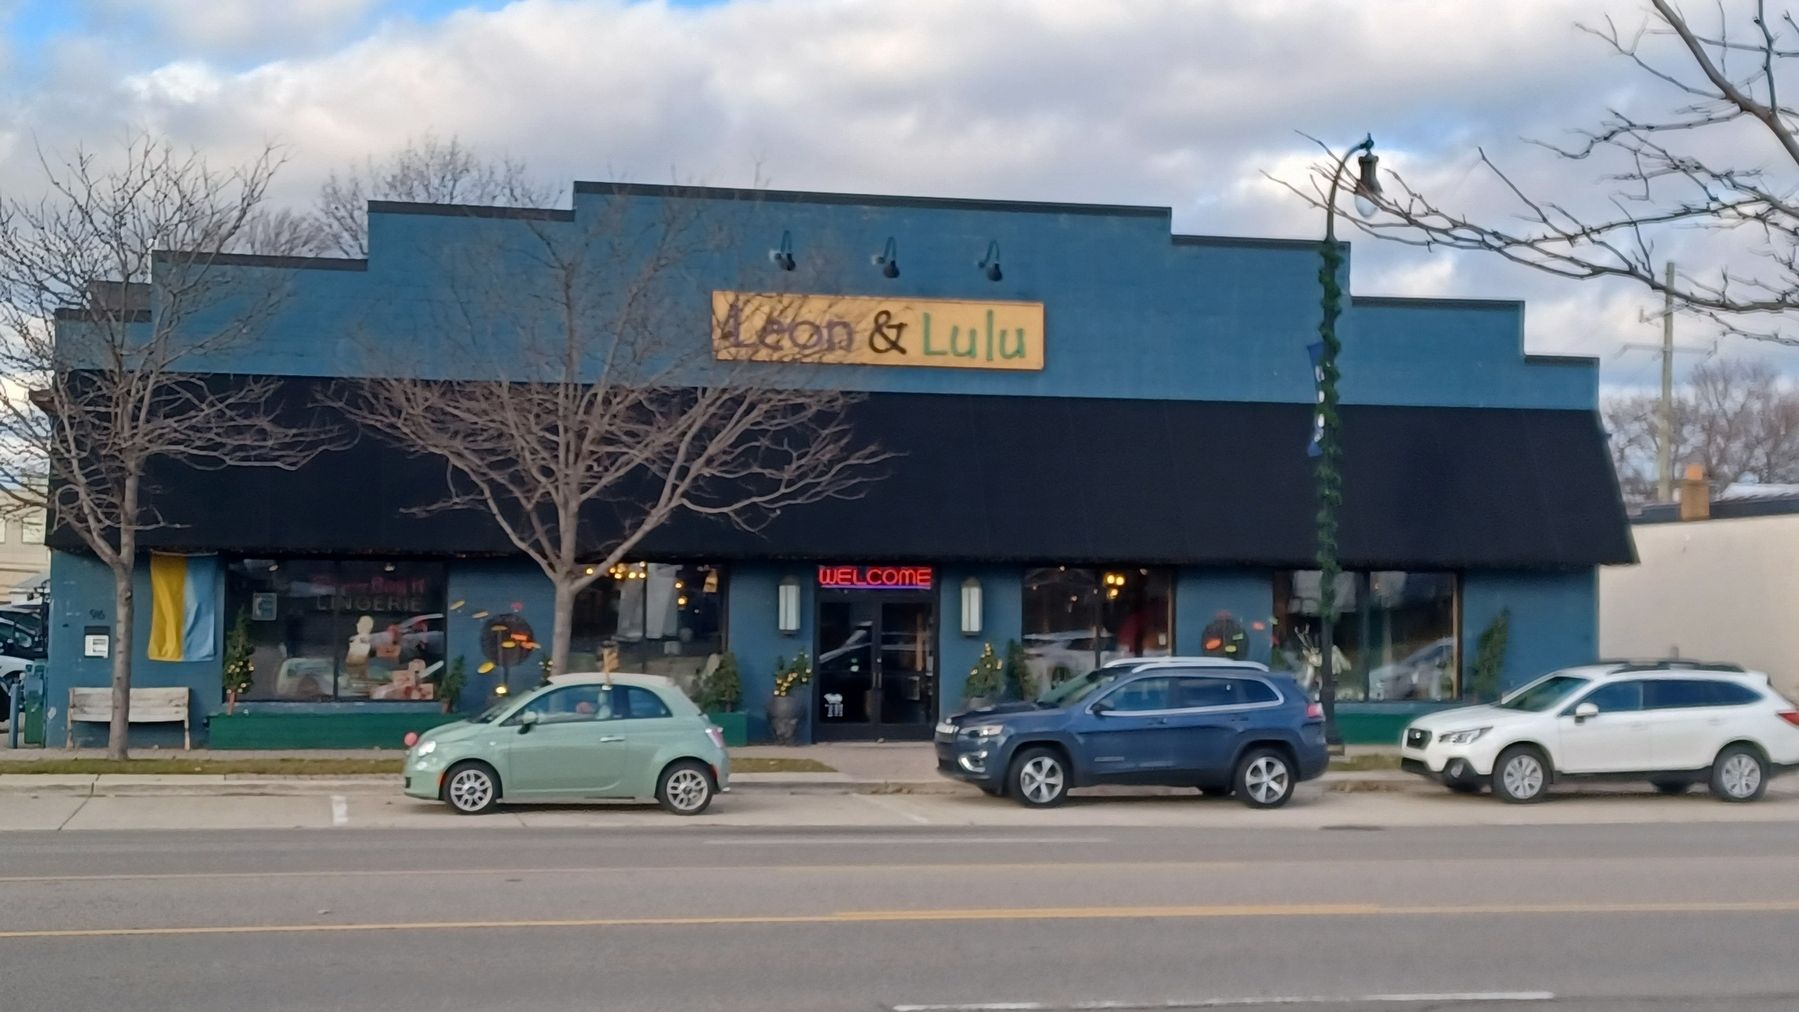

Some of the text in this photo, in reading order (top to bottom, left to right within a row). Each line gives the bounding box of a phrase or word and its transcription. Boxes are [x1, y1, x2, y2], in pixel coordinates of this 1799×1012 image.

[732, 303, 1026, 362] Leon & Lulu
[818, 567, 932, 586] WELCOME
[316, 594, 422, 612] LINGERIE
